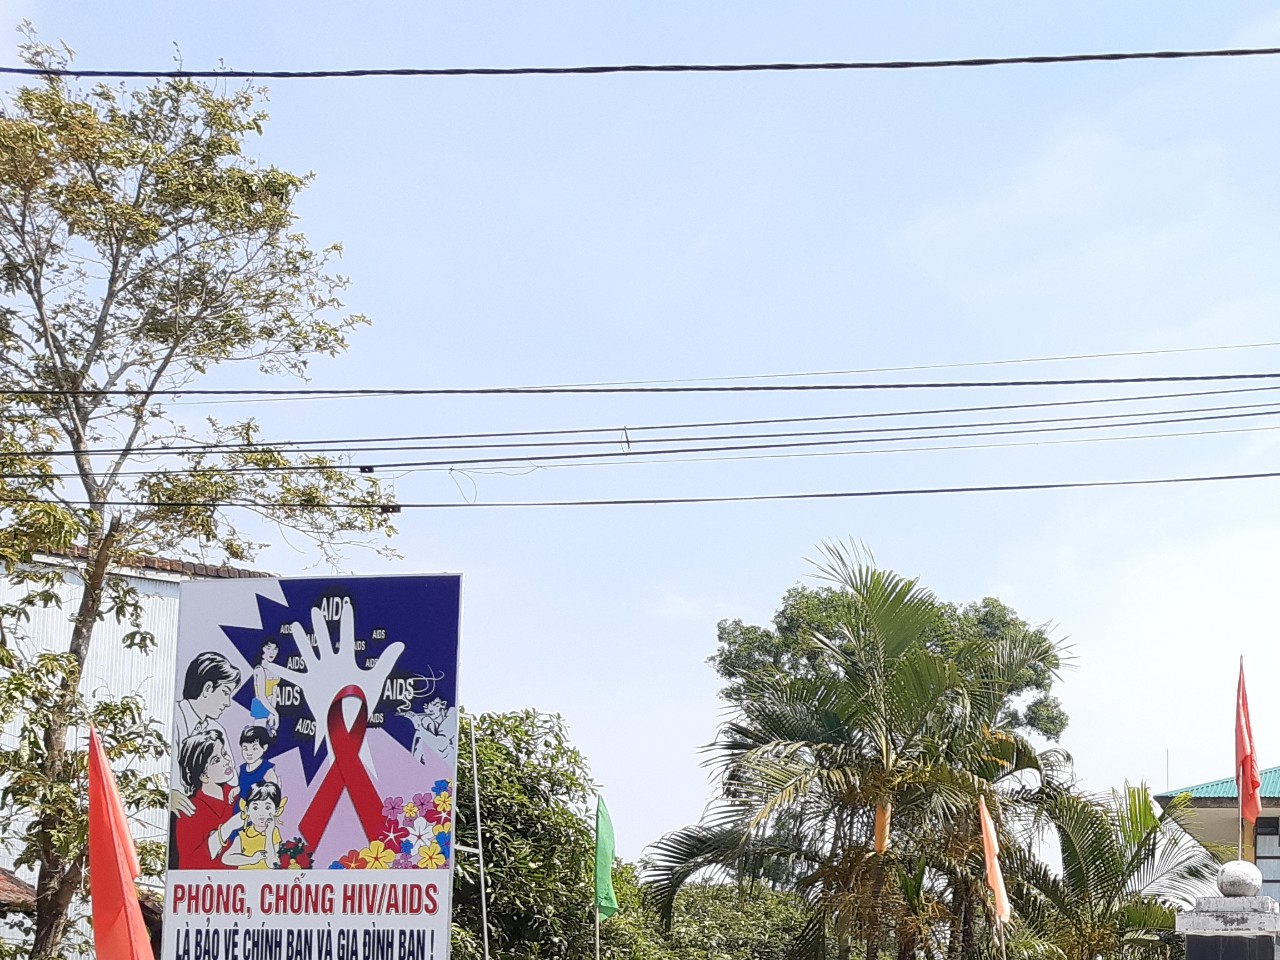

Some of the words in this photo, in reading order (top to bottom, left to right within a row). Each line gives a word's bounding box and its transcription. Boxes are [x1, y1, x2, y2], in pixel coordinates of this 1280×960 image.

[320, 596, 352, 621] AID
[372, 629, 386, 639] AIDS
[287, 656, 305, 669] AIDS
[275, 686, 301, 706] AIDS
[383, 678, 414, 700] AIDS
[295, 718, 316, 736] AIDS
[172, 875, 253, 919] PHÒNG,
[260, 872, 335, 916] CHỐNG
[342, 883, 440, 916] HIV/AIDS
